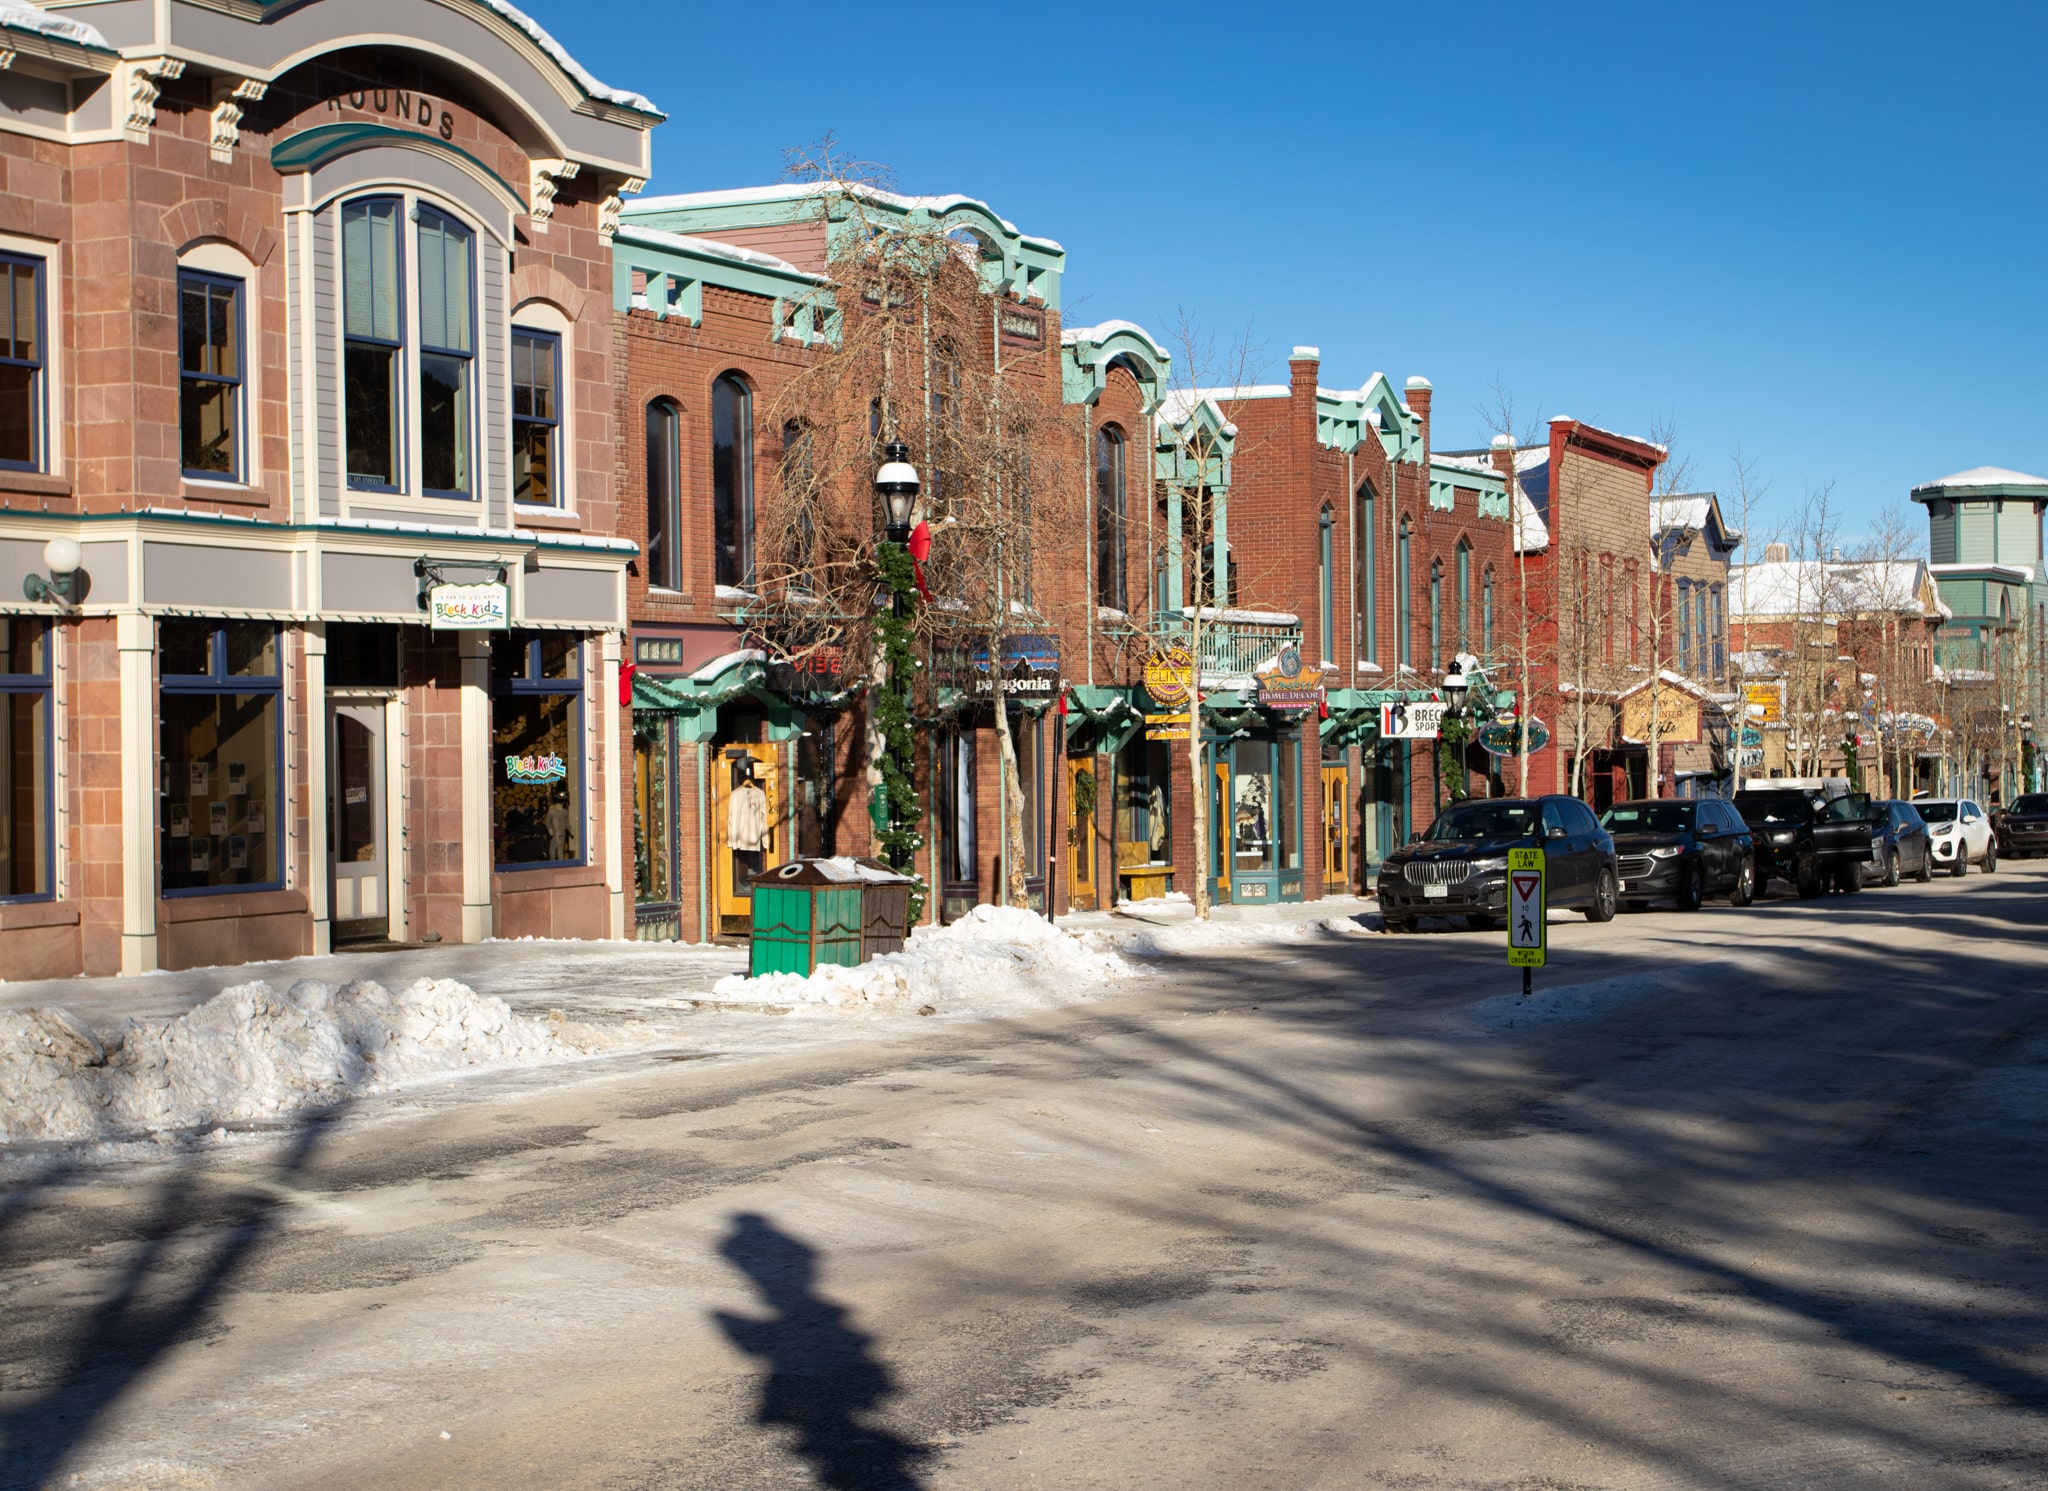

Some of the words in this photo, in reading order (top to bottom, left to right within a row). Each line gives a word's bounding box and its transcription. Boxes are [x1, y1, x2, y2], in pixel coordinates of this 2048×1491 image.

[435, 602, 467, 615] Breck
[471, 600, 503, 615] Kidz
[976, 677, 1051, 693] paagonia
[1262, 691, 1287, 700] HOME
[1289, 691, 1319, 700] DECOR
[1415, 722, 1440, 731] SPORT
[505, 756, 535, 772] Breck
[537, 751, 566, 772] Kidz
[1514, 851, 1538, 859] STATE
[1517, 860, 1534, 868] LAW
